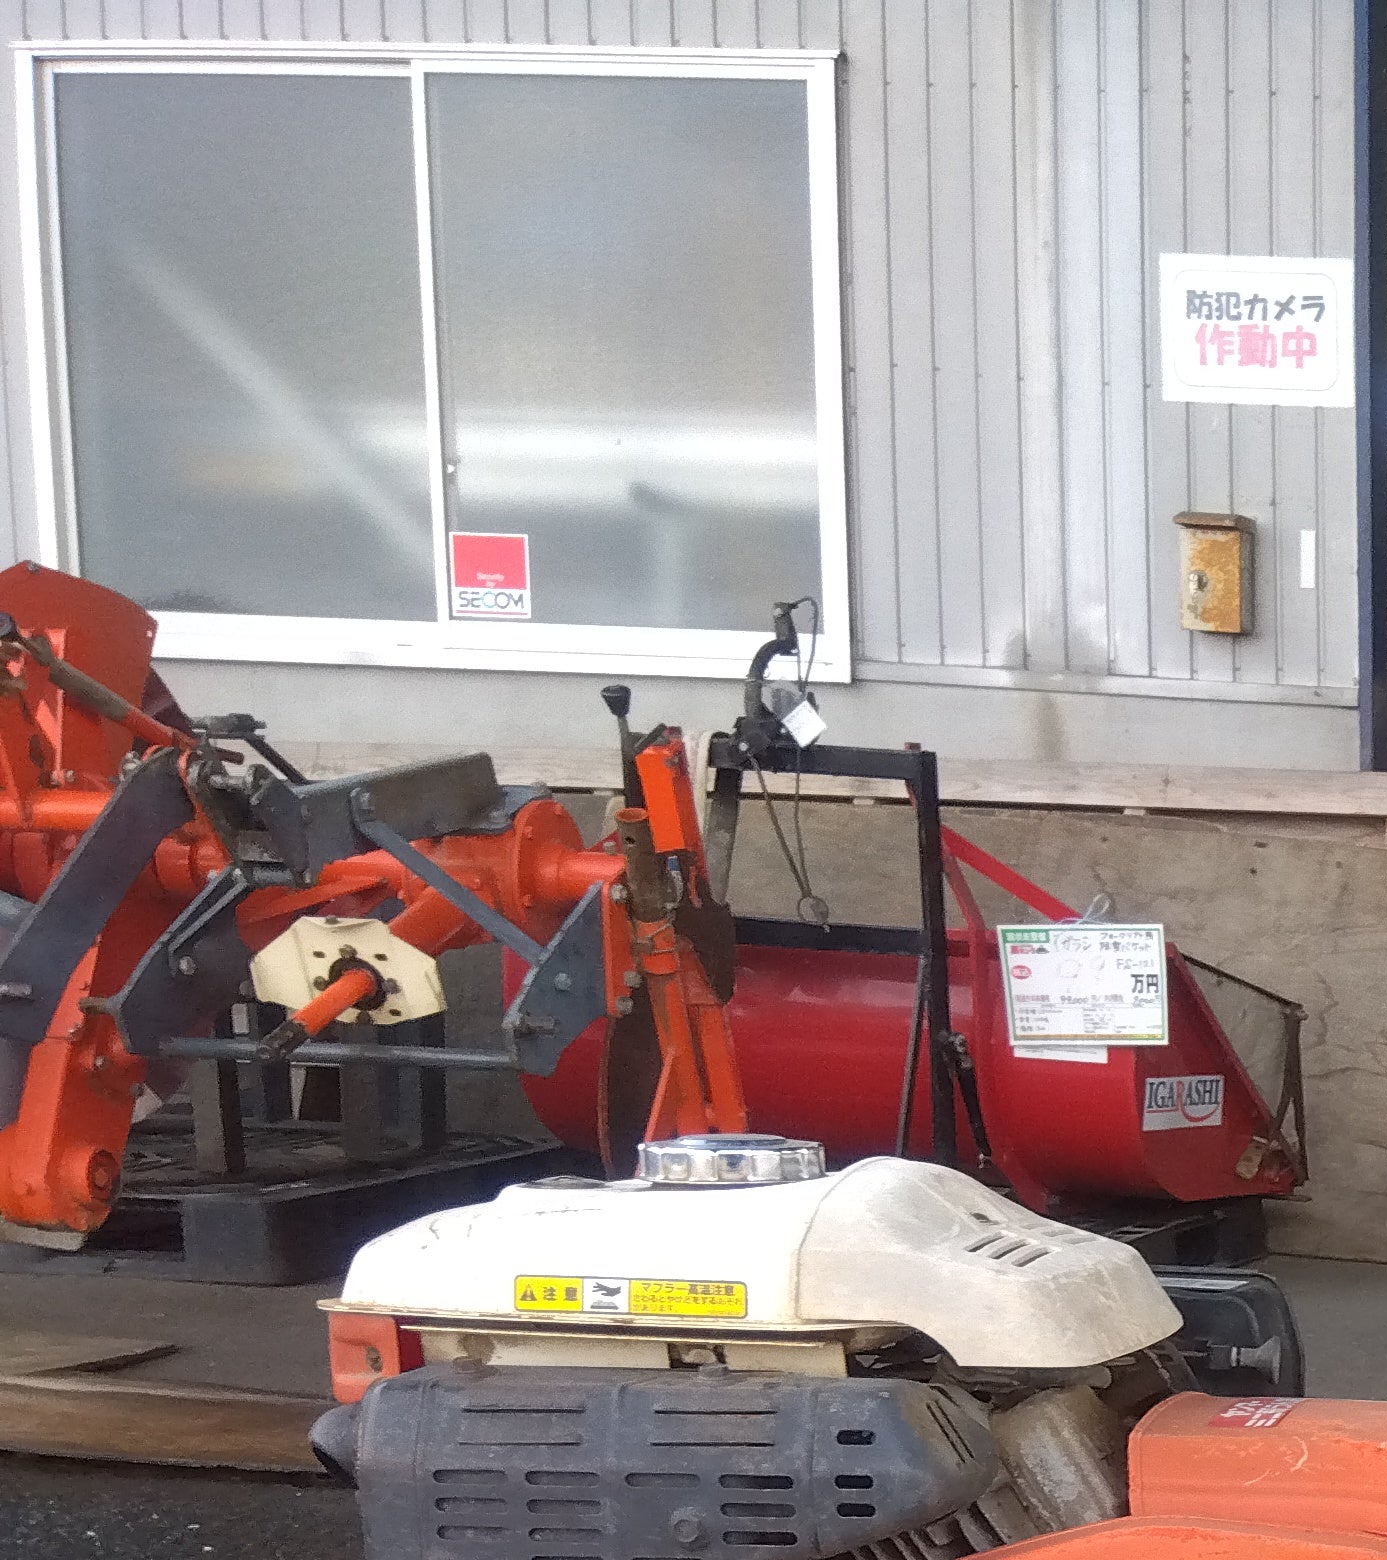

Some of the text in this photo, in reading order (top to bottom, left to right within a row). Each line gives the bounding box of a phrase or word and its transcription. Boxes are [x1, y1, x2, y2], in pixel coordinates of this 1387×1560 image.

[1186, 290, 1326, 322] 防犯カメラ
[1195, 323, 1318, 369] 作動中
[459, 591, 524, 609] SECOM
[1130, 974, 1159, 994] 万円
[1146, 1079, 1221, 1112] IGARASHI
[543, 1286, 578, 1301] 注意
